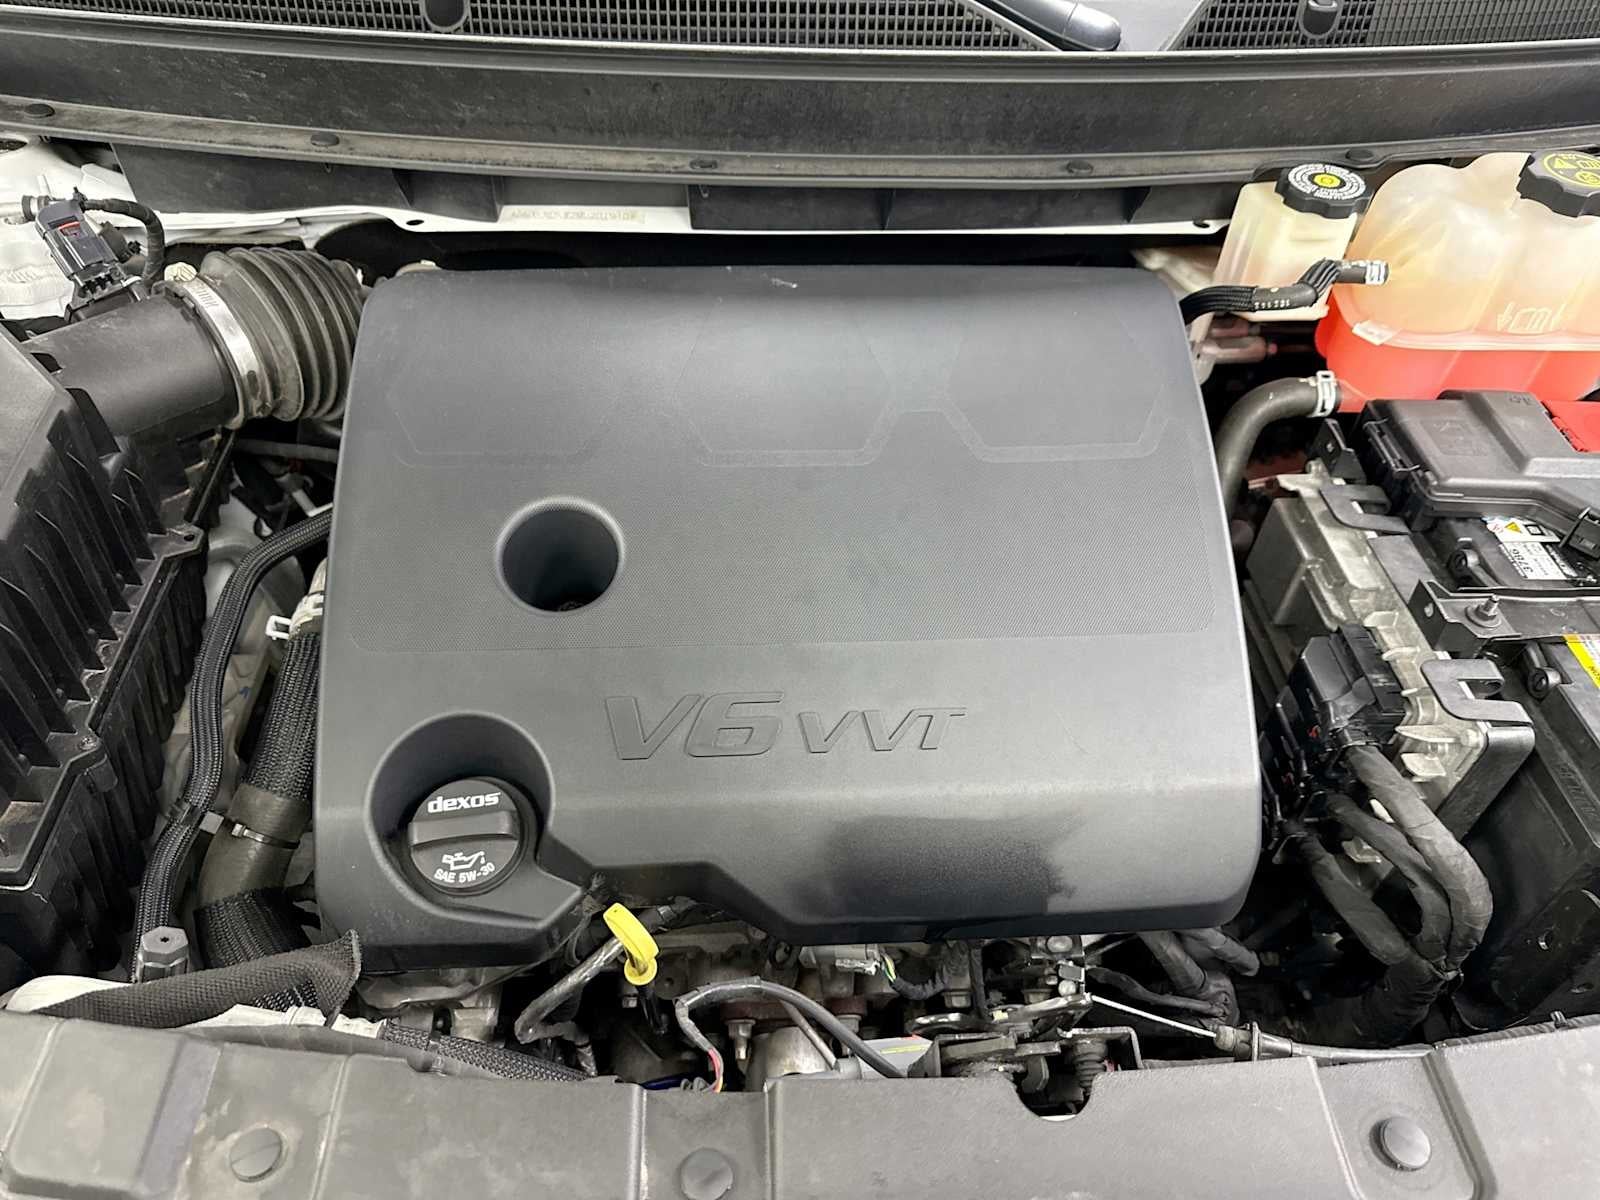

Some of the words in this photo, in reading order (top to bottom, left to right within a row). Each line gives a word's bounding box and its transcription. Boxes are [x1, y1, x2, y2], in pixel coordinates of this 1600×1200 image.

[604, 692, 784, 760] V6
[798, 707, 966, 754] VVT
[427, 792, 501, 813] dexos
[434, 868, 456, 883] SAE
[458, 862, 496, 883] 5W-30
